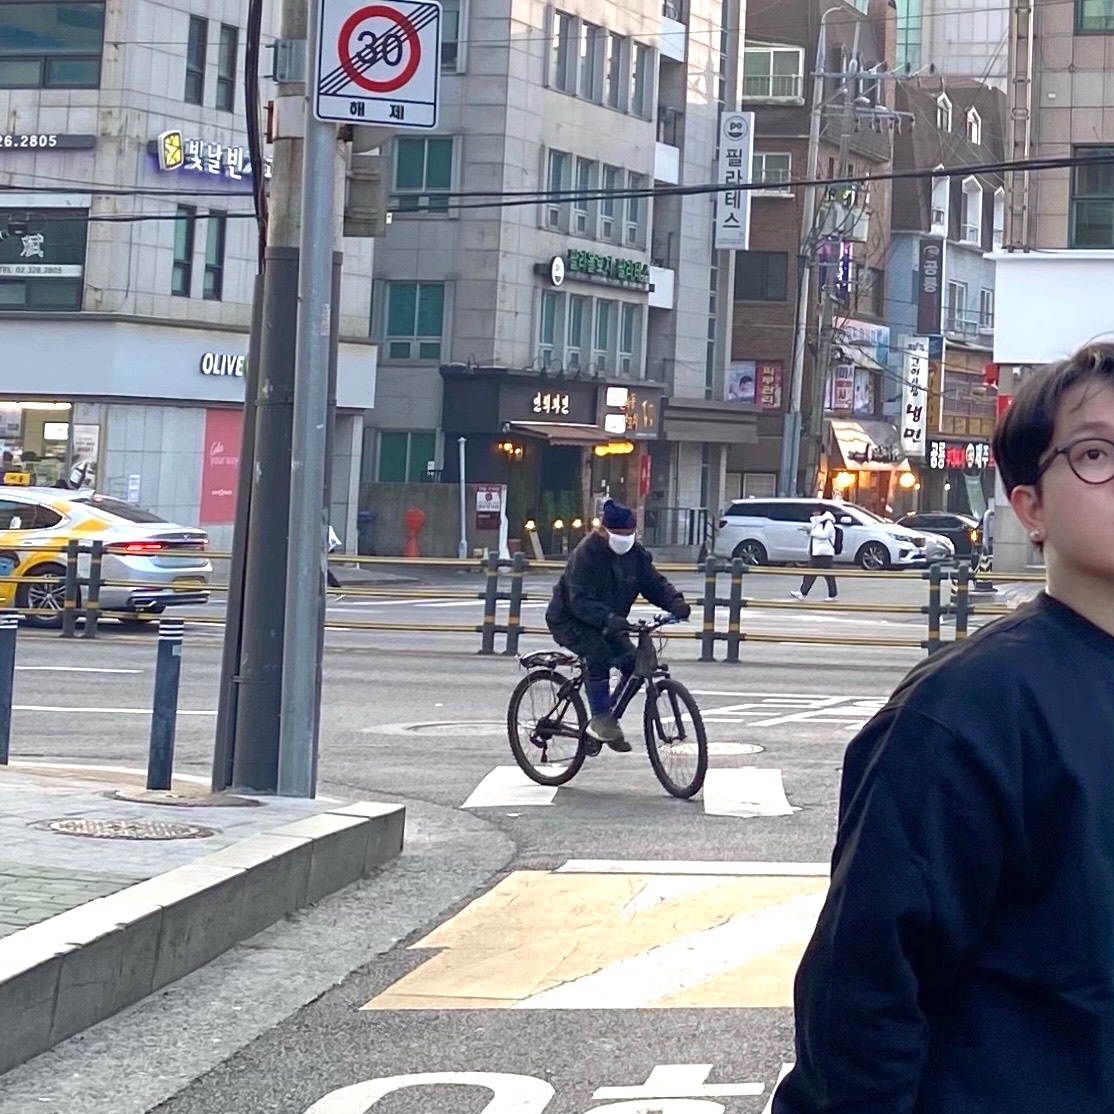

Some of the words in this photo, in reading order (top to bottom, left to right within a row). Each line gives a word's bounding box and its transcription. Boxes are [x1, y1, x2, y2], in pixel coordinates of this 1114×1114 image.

[357, 31, 404, 67] 30
[722, 148, 743, 229] 필라테스
[202, 352, 246, 377] OLIVE
[903, 404, 923, 444] 냉면
